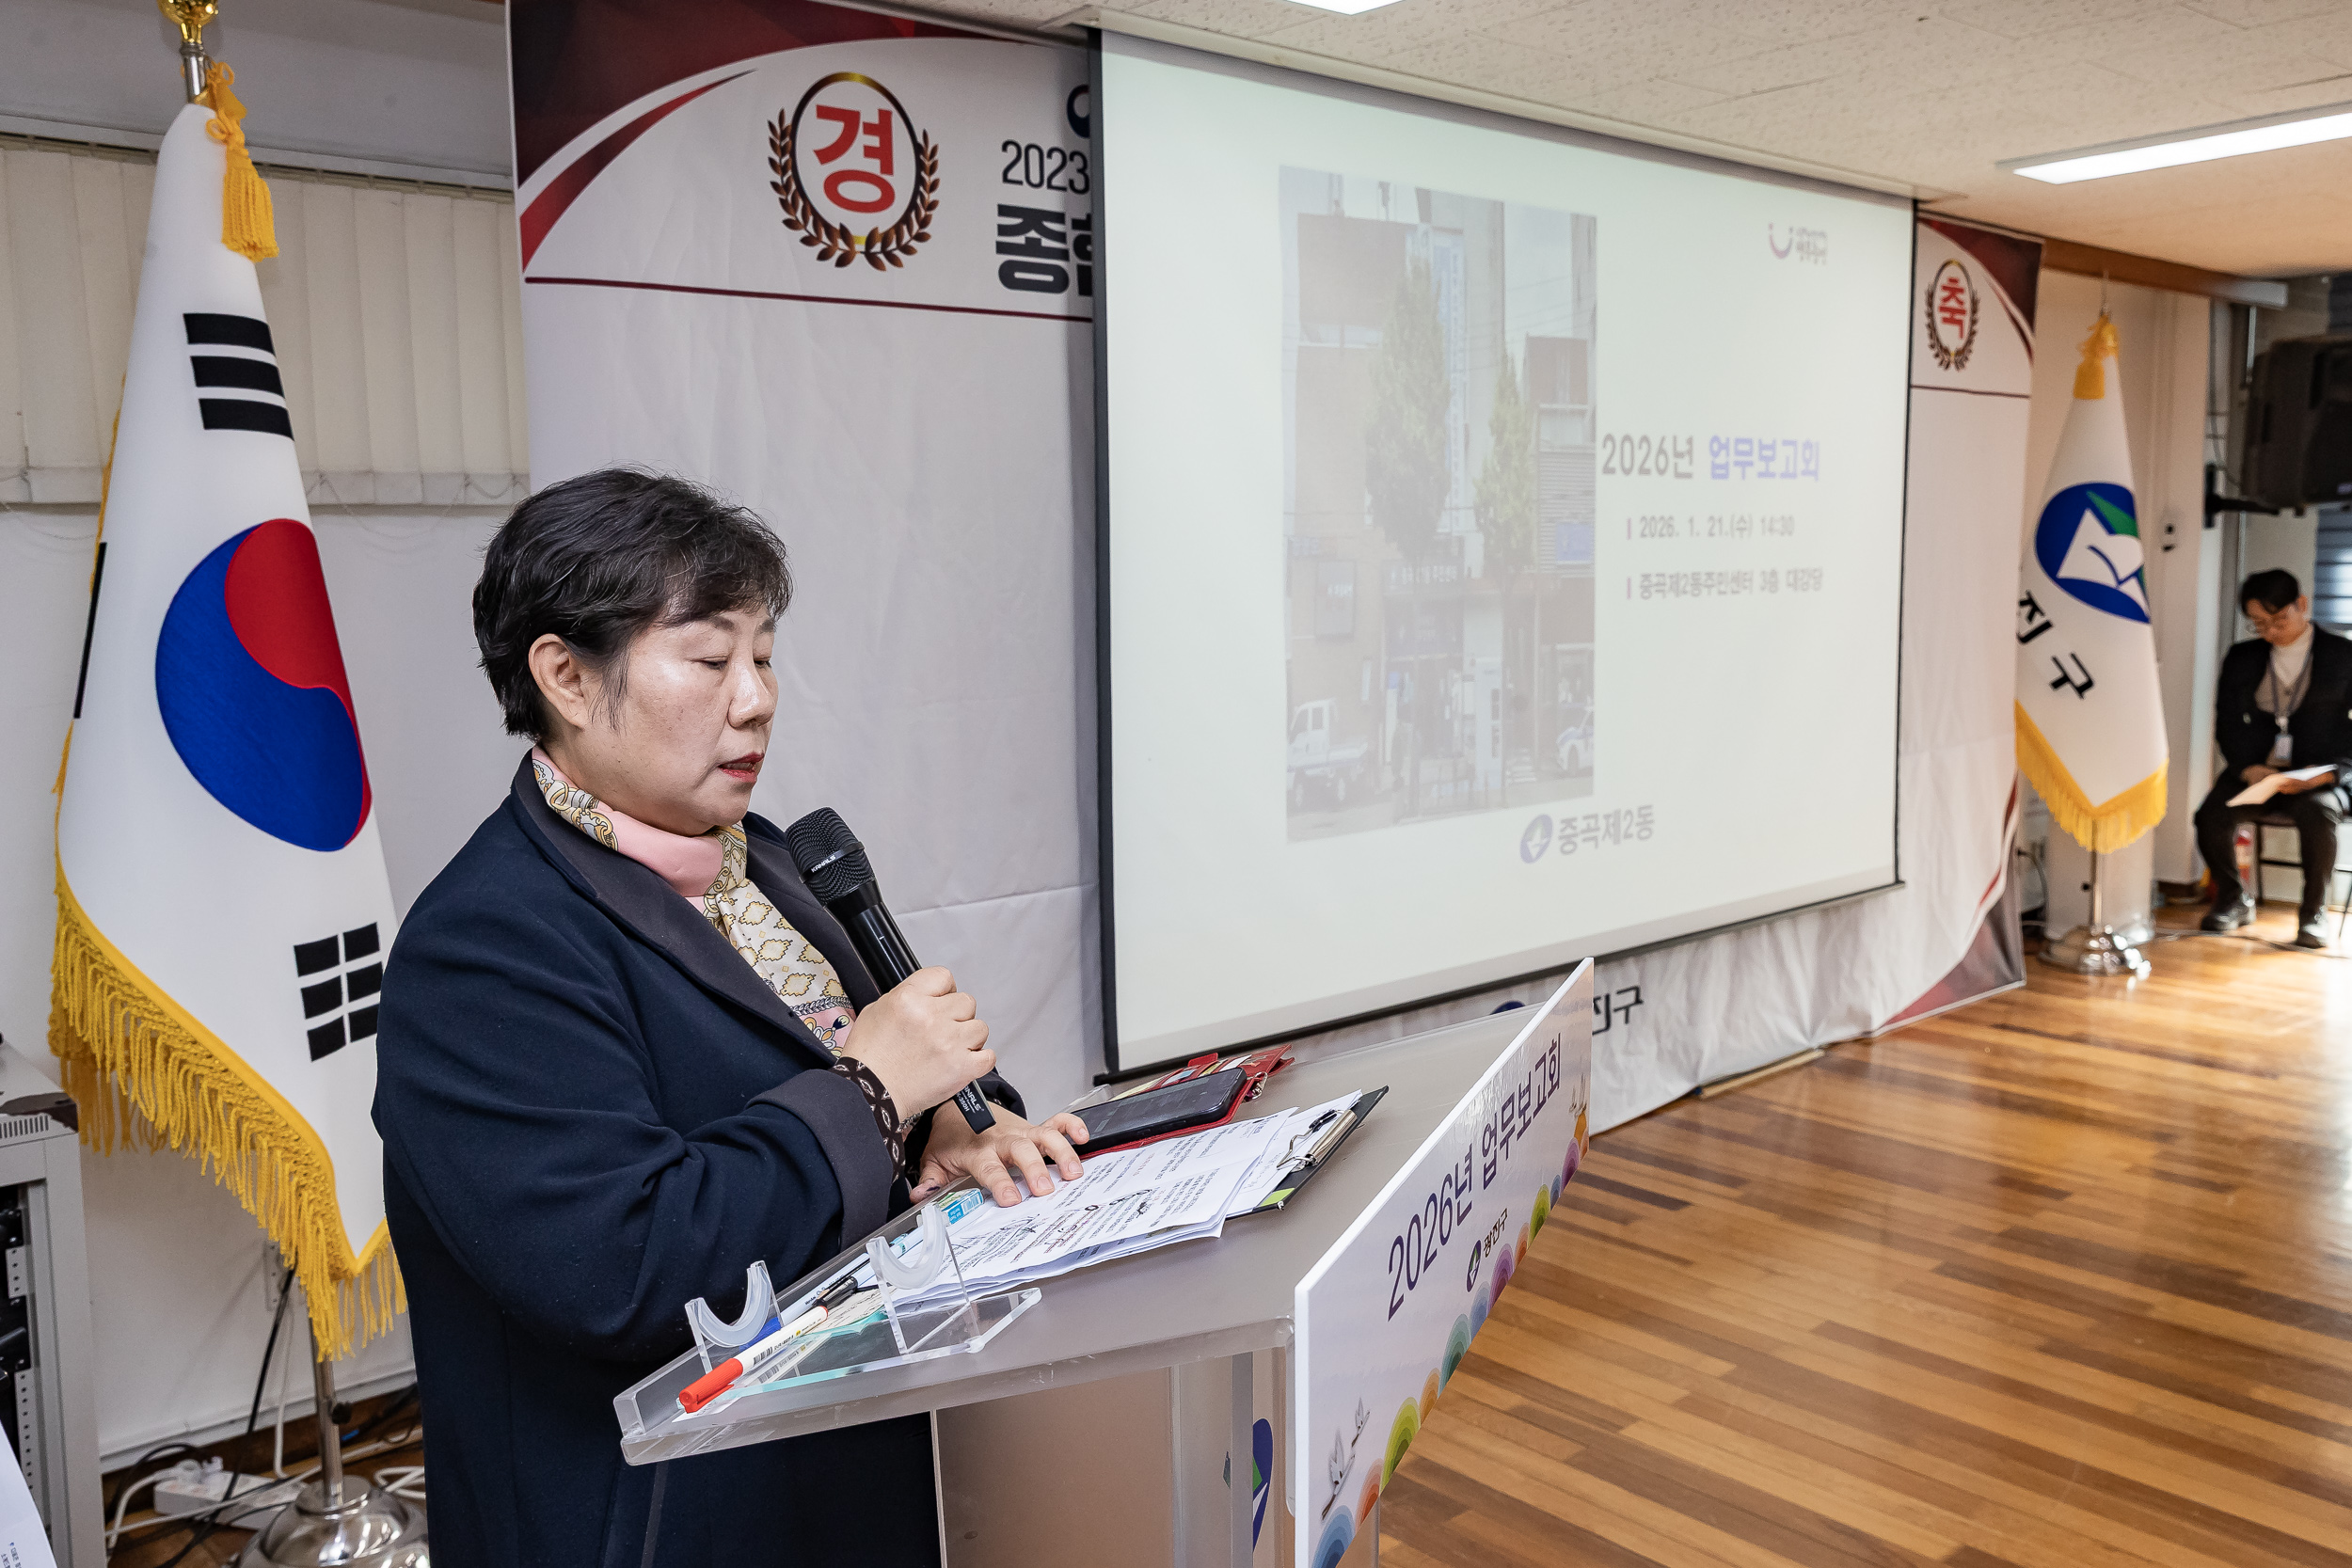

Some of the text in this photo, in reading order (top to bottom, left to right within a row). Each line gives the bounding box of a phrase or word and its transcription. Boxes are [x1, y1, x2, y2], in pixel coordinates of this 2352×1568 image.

[813, 103, 896, 214] 경
[1001, 138, 1090, 196] 2023
[995, 203, 1093, 297] 종
[1938, 277, 1967, 340] 축
[1601, 434, 1820, 482] 2026년 업무보고회
[1639, 515, 1680, 539] 2026.
[1759, 567, 1779, 594] 3층
[1557, 804, 1656, 856] 중곡제2동
[811, 854, 836, 873] KANALS
[1387, 1032, 1562, 1323] 2026년 업무보고회
[1483, 1208, 1508, 1259] 광진구
